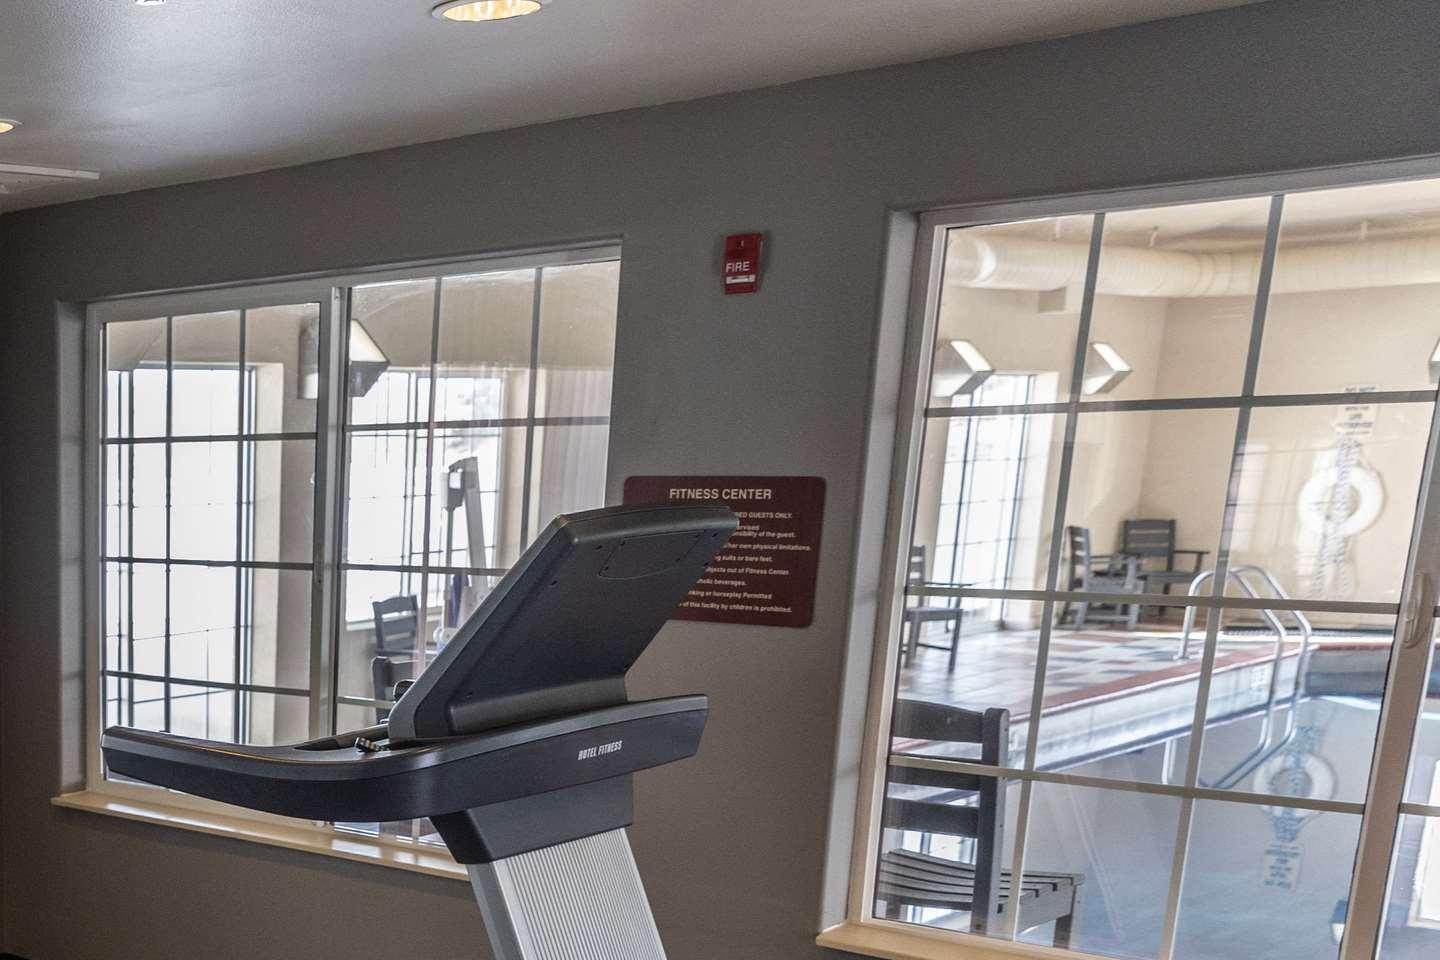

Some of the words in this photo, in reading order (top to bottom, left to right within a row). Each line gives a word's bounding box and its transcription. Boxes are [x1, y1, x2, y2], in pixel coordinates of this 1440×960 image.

[725, 261, 751, 273] FIRE
[669, 488, 720, 500] FITNESS
[721, 488, 773, 500] CENTER
[749, 511, 774, 519] GUESTS
[578, 747, 597, 760] HOTEL
[598, 741, 622, 756] FITNESS
